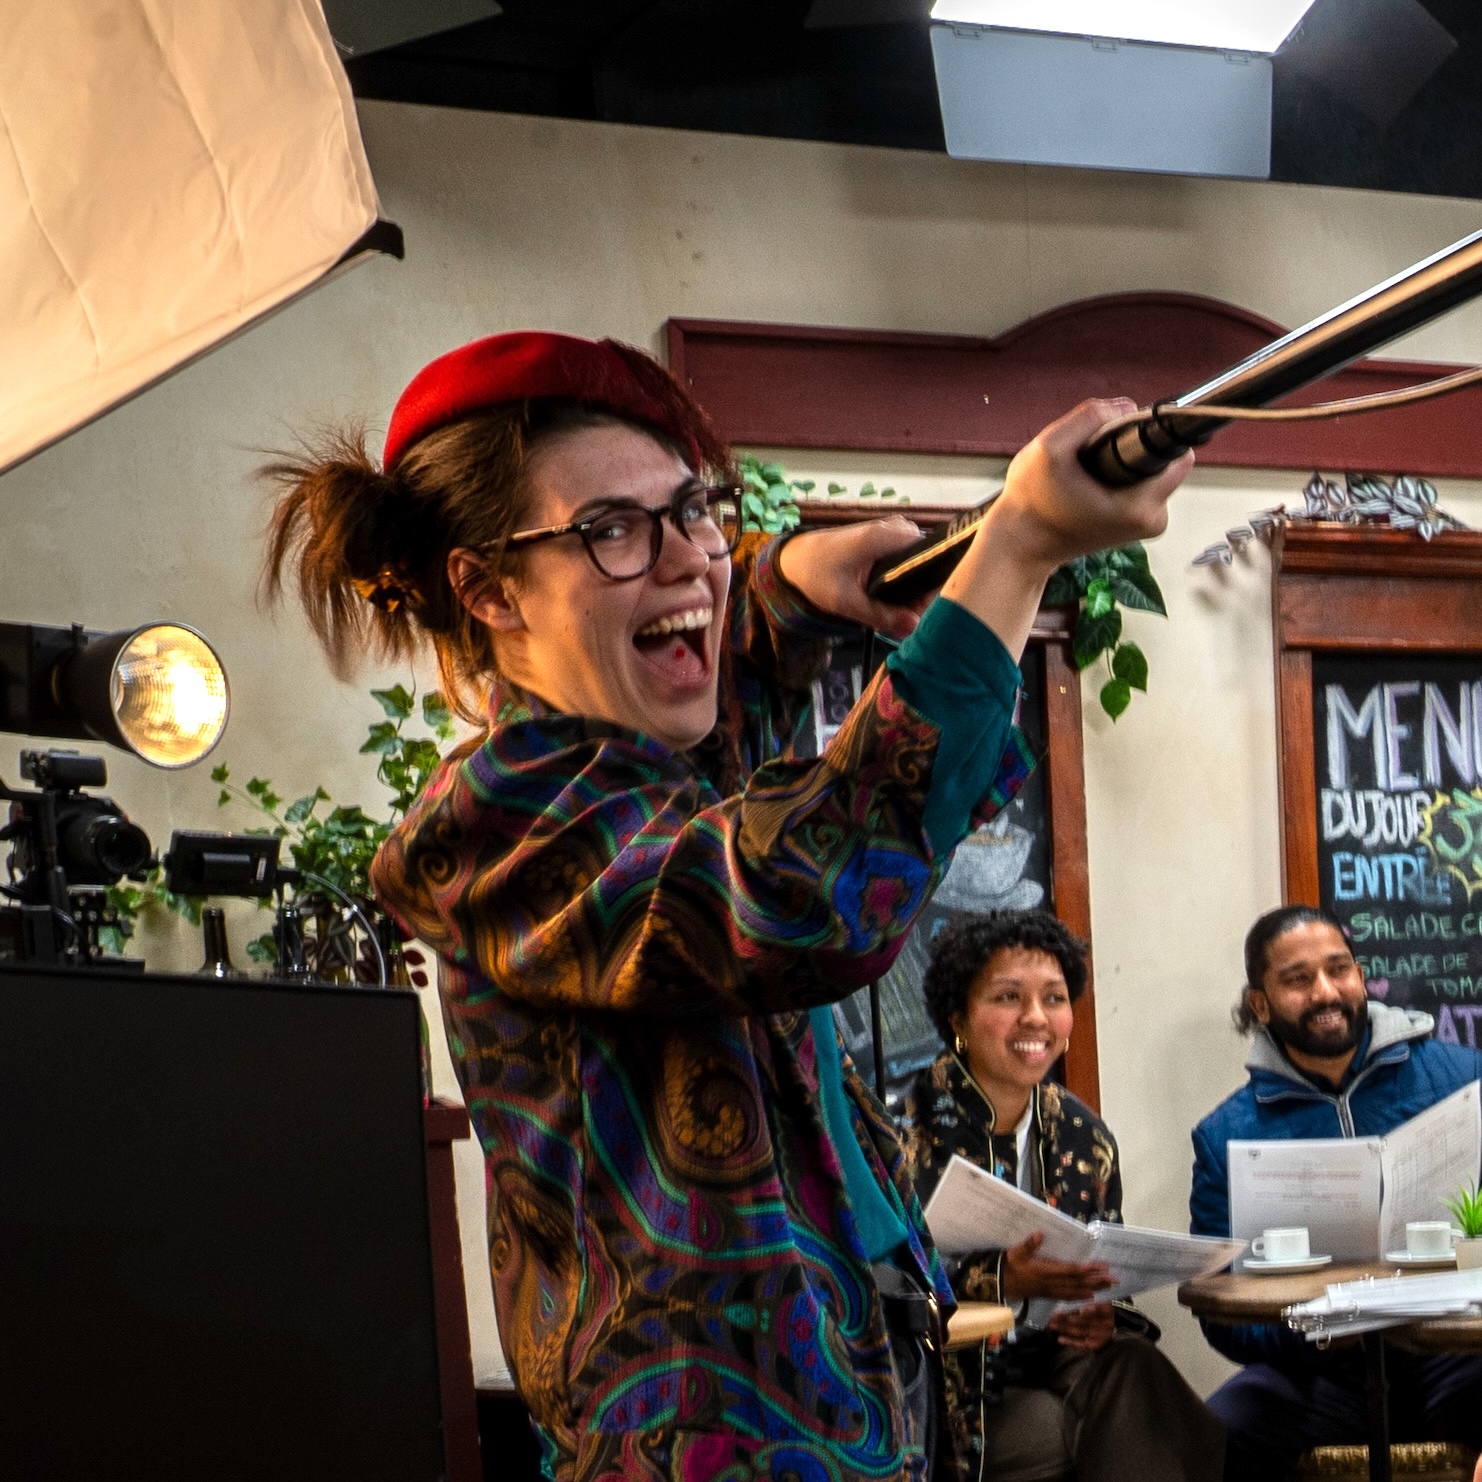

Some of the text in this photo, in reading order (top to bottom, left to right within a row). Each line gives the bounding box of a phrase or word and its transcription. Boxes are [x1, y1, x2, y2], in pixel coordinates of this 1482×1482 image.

[1351, 912, 1457, 943] SALADE
[1357, 953, 1469, 978] SALADE DE
